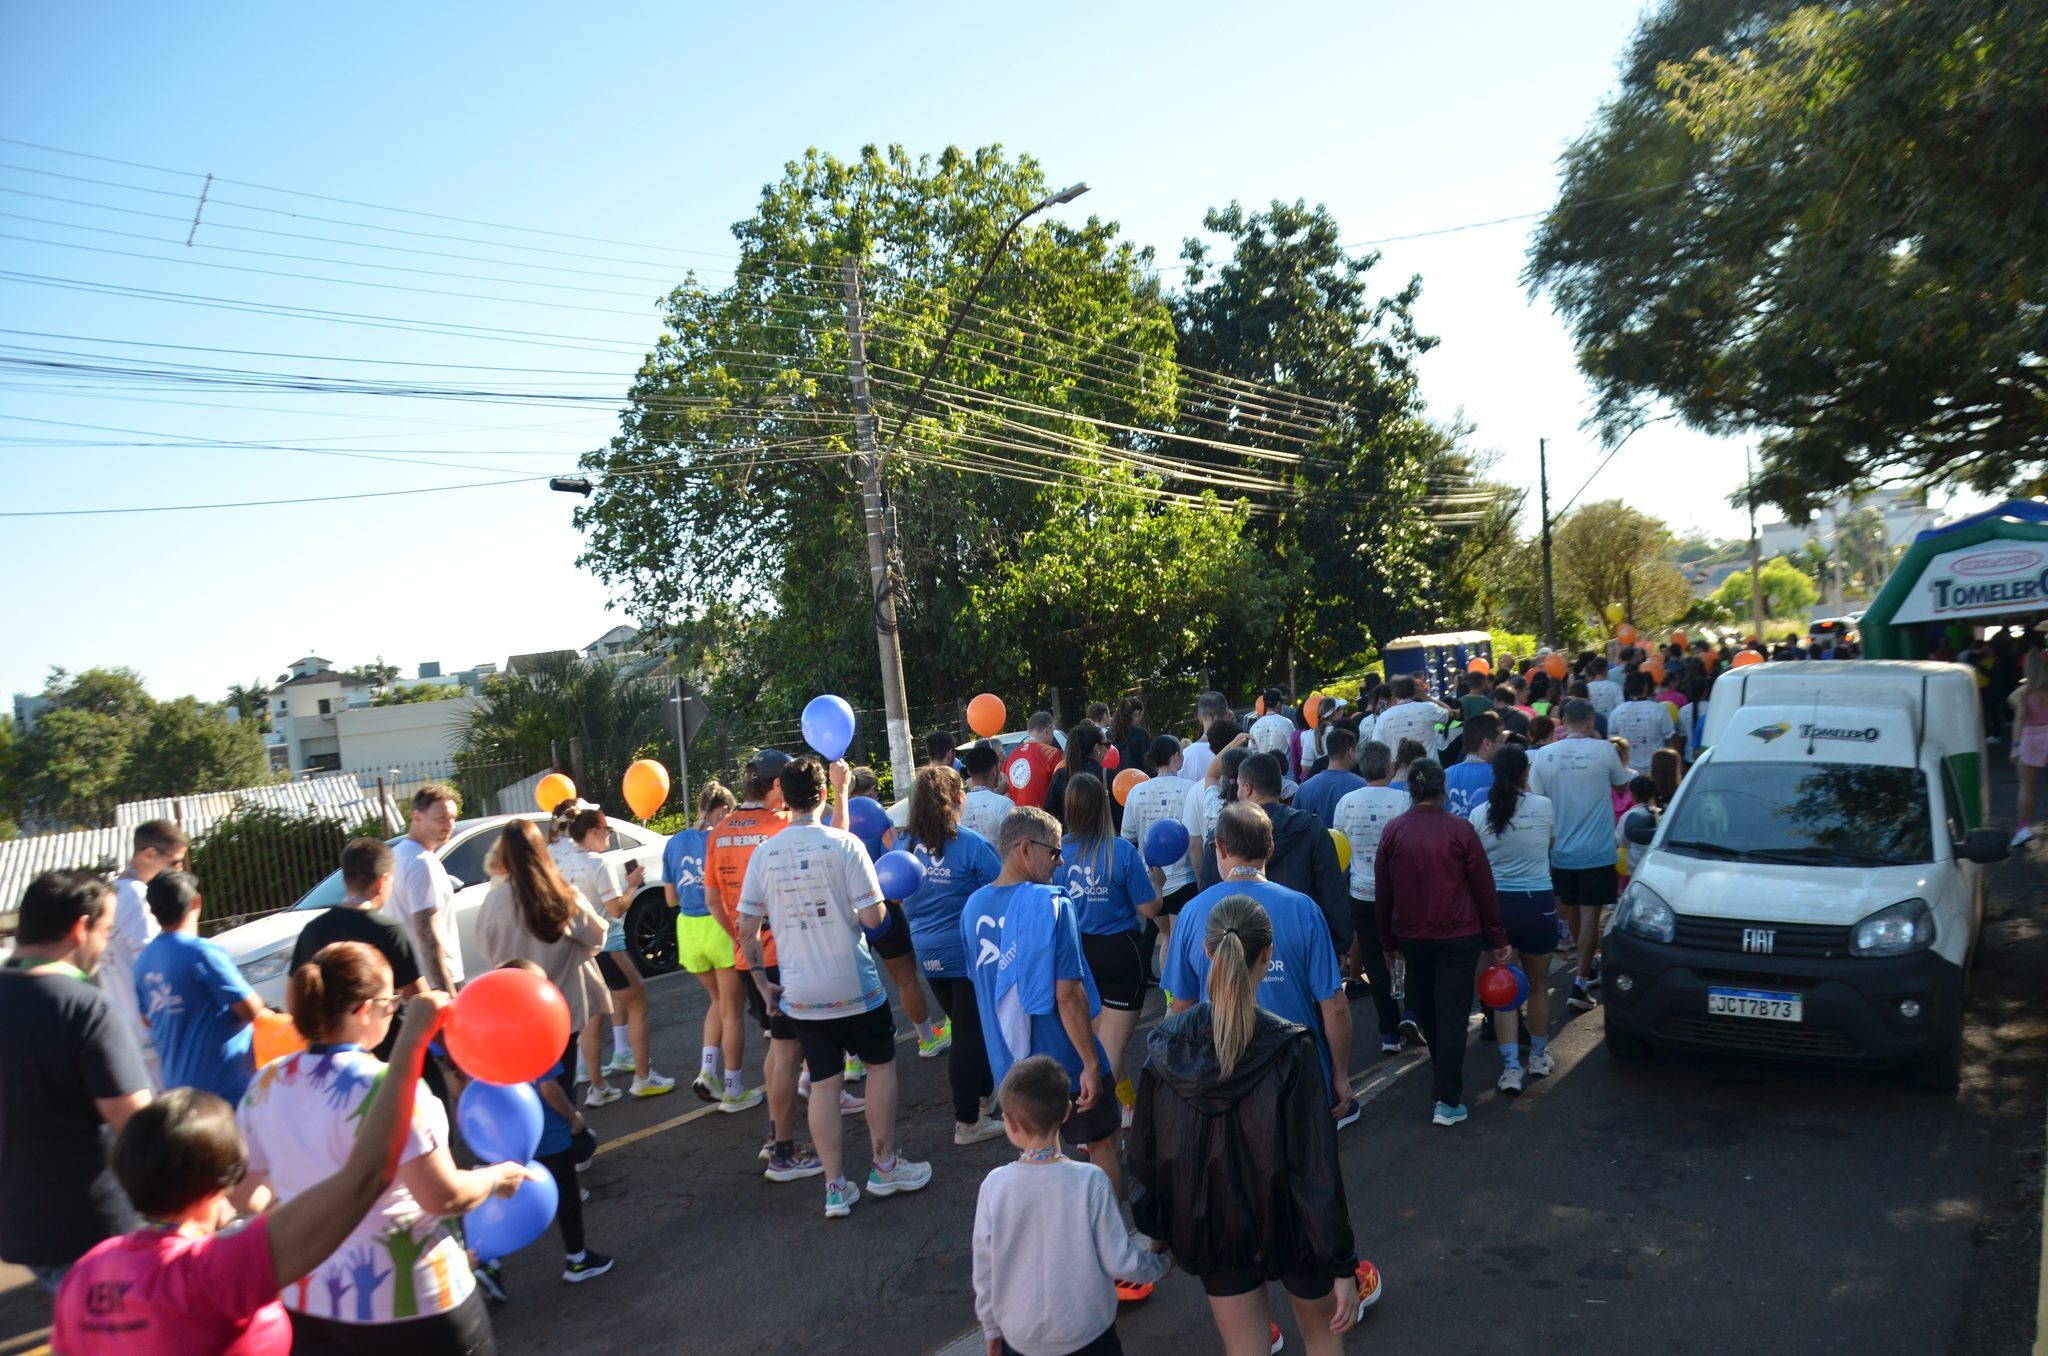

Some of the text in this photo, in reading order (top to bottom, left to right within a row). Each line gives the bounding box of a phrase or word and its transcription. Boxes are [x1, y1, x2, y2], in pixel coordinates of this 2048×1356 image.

[1799, 724, 1879, 741] TOMELERO
[927, 867, 951, 877] GCOR
[1084, 886, 1108, 895] GCOR
[1742, 928, 1776, 954] FIAT
[1267, 960, 1284, 972] OR
[1716, 996, 1792, 1018] JCT7B73
